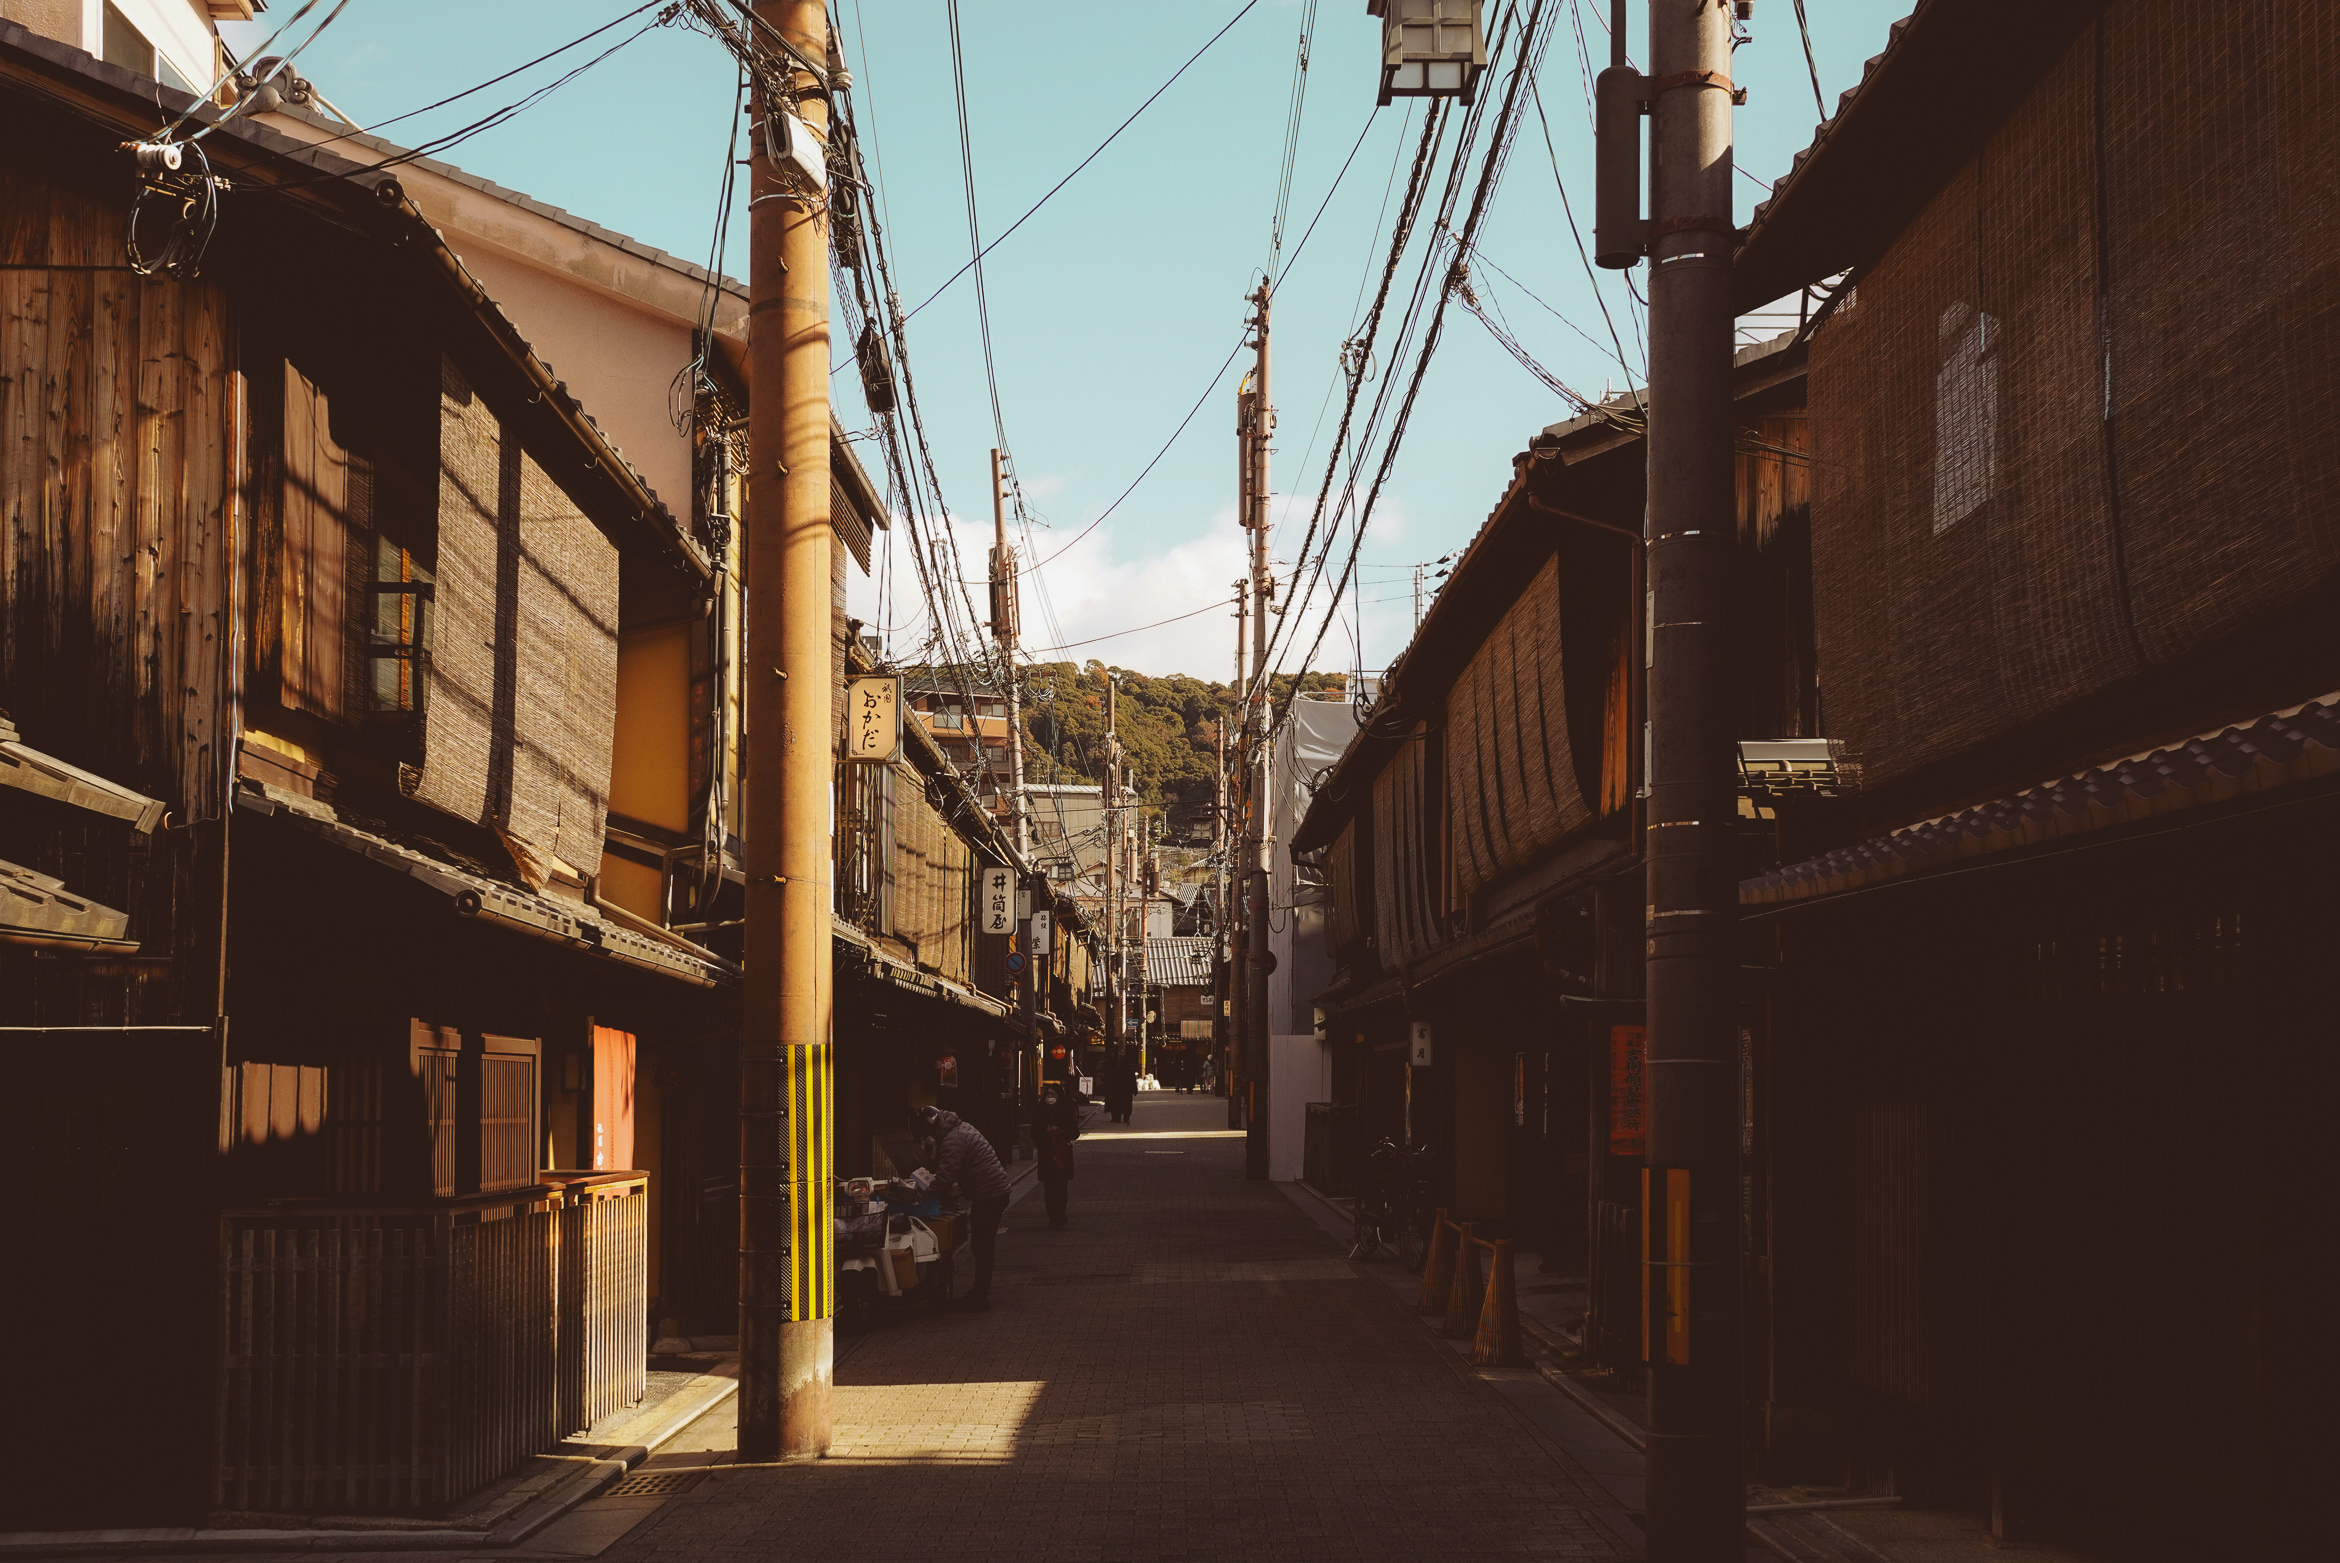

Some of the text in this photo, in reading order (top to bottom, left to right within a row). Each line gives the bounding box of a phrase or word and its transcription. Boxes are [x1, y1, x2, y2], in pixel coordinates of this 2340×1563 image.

[862, 689, 881, 750] おかだ
[989, 872, 1007, 930] 井筒屋
